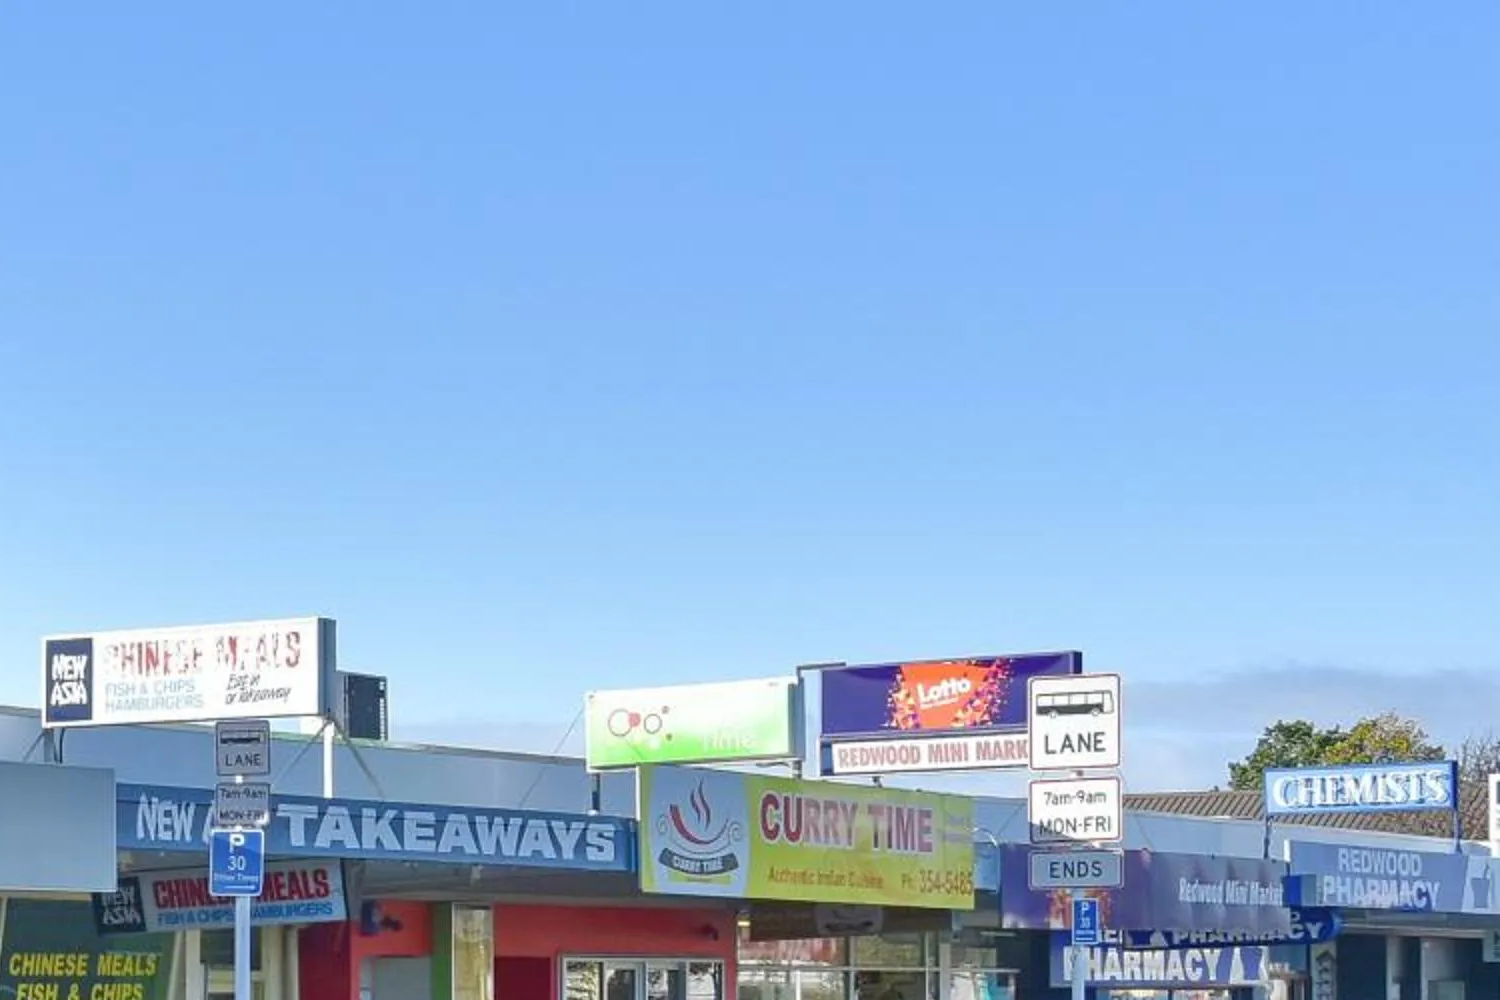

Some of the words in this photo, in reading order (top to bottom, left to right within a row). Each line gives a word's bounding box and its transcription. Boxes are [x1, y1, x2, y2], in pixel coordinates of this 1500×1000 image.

[52, 654, 88, 681] NEW
[51, 680, 88, 706] ASIA
[153, 678, 196, 693] CHIPS
[916, 677, 972, 701] Lotto
[105, 693, 204, 713] HAMBURGERS
[837, 744, 921, 769] REDWOOD
[927, 742, 969, 763] MINI
[975, 739, 1029, 761] MARK
[1044, 731, 1106, 755] LANE
[225, 753, 262, 767] LANE
[219, 787, 267, 800] 7am-9am
[1043, 789, 1107, 806] 7am-9am
[1273, 768, 1450, 808] CHEMISTS
[135, 793, 196, 844] NEW
[219, 810, 266, 822] MON-FRI
[760, 789, 859, 849] CURRY
[867, 801, 934, 854] TIME
[1038, 816, 1112, 835] MON-FRI
[228, 833, 246, 854] P
[275, 803, 617, 863] TAKEAWAYS
[227, 855, 247, 871] 30
[1049, 861, 1103, 879] ENDS
[1338, 848, 1423, 876] REDWOOD
[153, 877, 233, 910] CHIN
[260, 868, 332, 903] MEALS
[1179, 877, 1224, 903] Redwood
[1225, 879, 1249, 904] Mini
[1323, 875, 1441, 910] PHARMACY
[8, 952, 90, 977] CHINESE
[97, 952, 158, 977] MEALS
